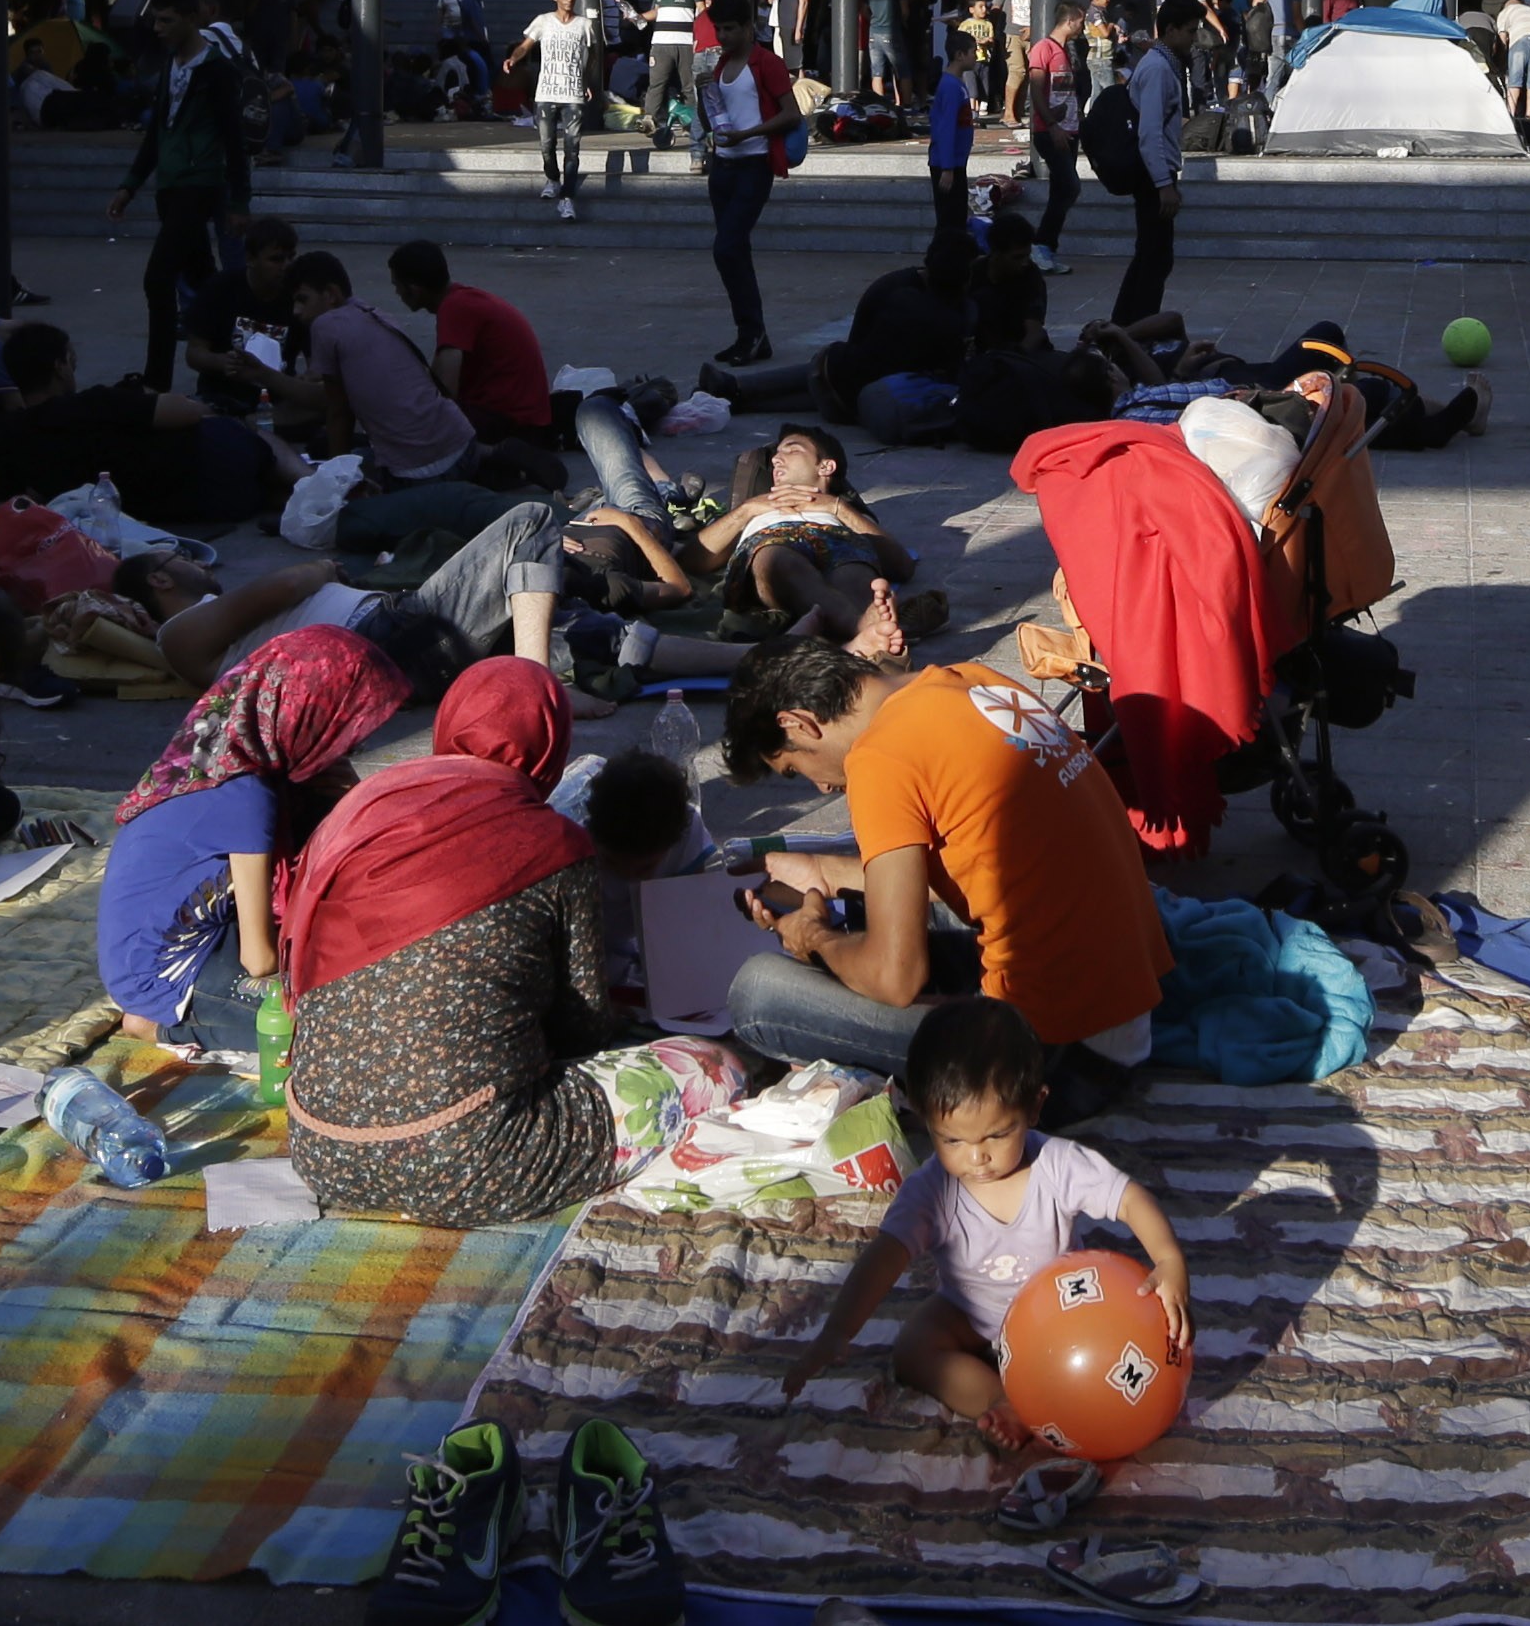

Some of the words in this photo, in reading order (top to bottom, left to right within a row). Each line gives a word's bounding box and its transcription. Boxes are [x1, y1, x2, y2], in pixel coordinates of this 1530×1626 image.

[541, 75, 559, 86] ALL
[1068, 1277, 1088, 1297] M
[1121, 1363, 1144, 1389] M
